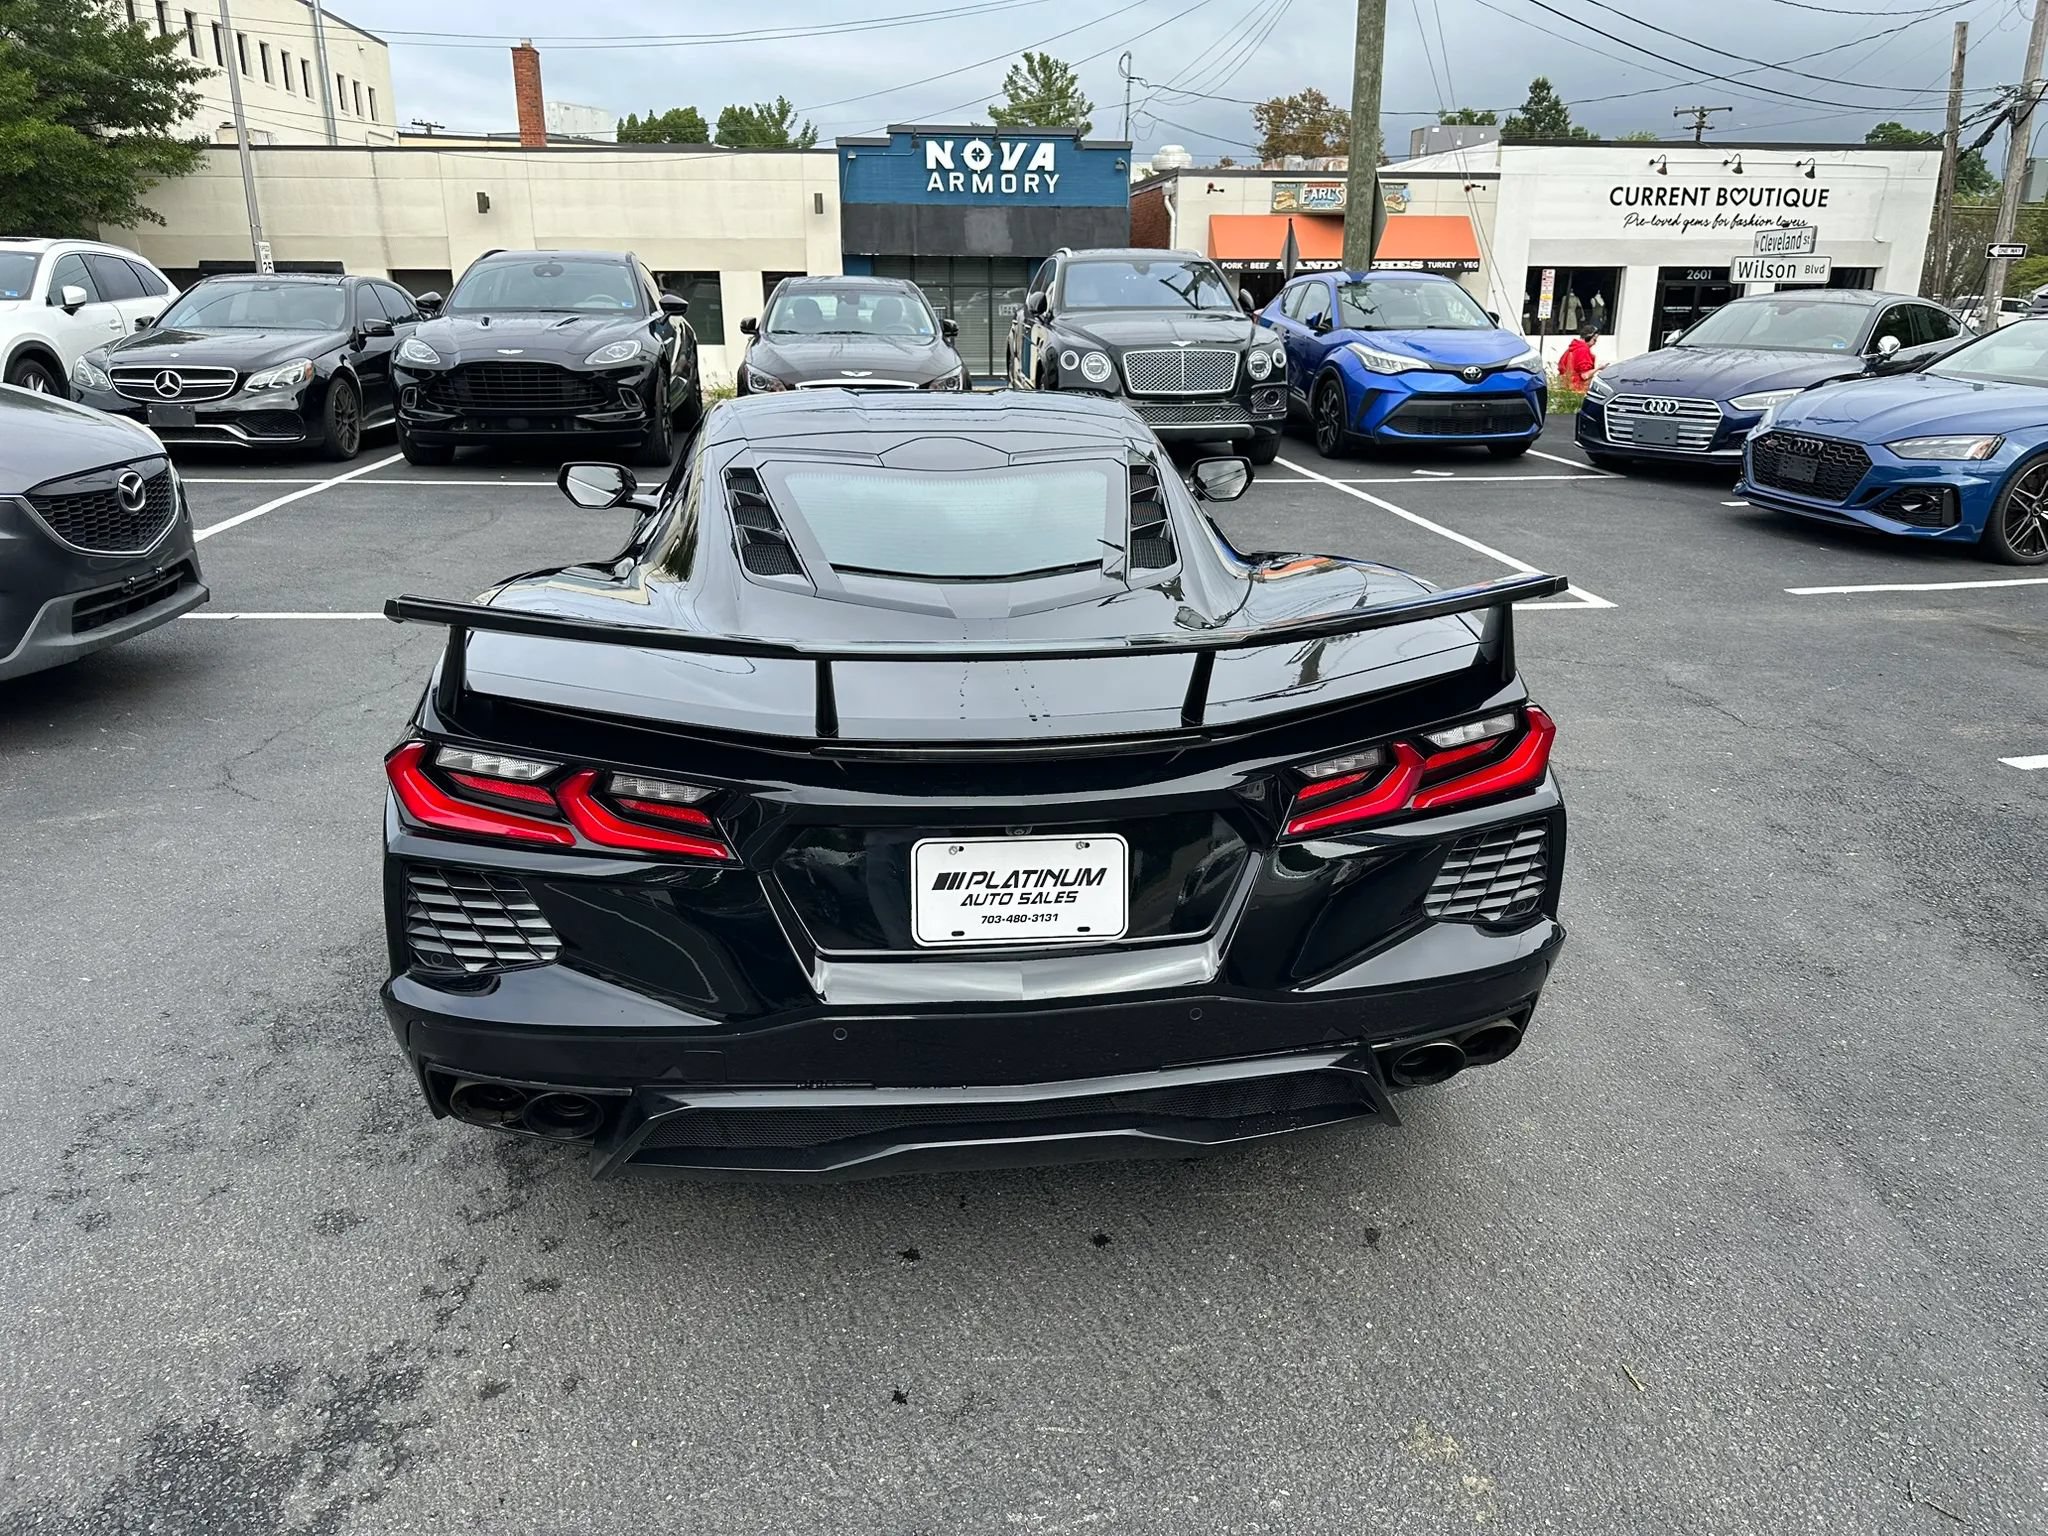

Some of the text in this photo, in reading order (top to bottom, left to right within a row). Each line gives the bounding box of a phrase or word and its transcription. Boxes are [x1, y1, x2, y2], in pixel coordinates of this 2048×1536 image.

[926, 139, 1055, 172] NOVA
[927, 172, 1060, 194] ARMORY
[1301, 187, 1345, 206] EARL'S
[1609, 186, 1830, 208] CURRENT BOUTIQUE
[1623, 212, 1682, 229] Pre-loved
[1681, 217, 1711, 234] gems
[1711, 213, 1731, 229] for
[1730, 213, 1774, 229] fashion
[1760, 230, 1803, 252] Cleveland
[1803, 235, 1810, 245] St
[263, 261, 273, 273] 25
[1221, 261, 1243, 270] PORK
[1249, 261, 1270, 270] BEEF
[1427, 261, 1457, 269] TURKEY
[1463, 261, 1479, 269] VEG
[1686, 269, 1712, 280] 2601
[1738, 259, 1826, 279] Wilson Blvd
[965, 867, 1107, 890] PLATINUM
[960, 890, 1079, 907] AUTO SALES
[981, 913, 1059, 925] 703-480-3131
